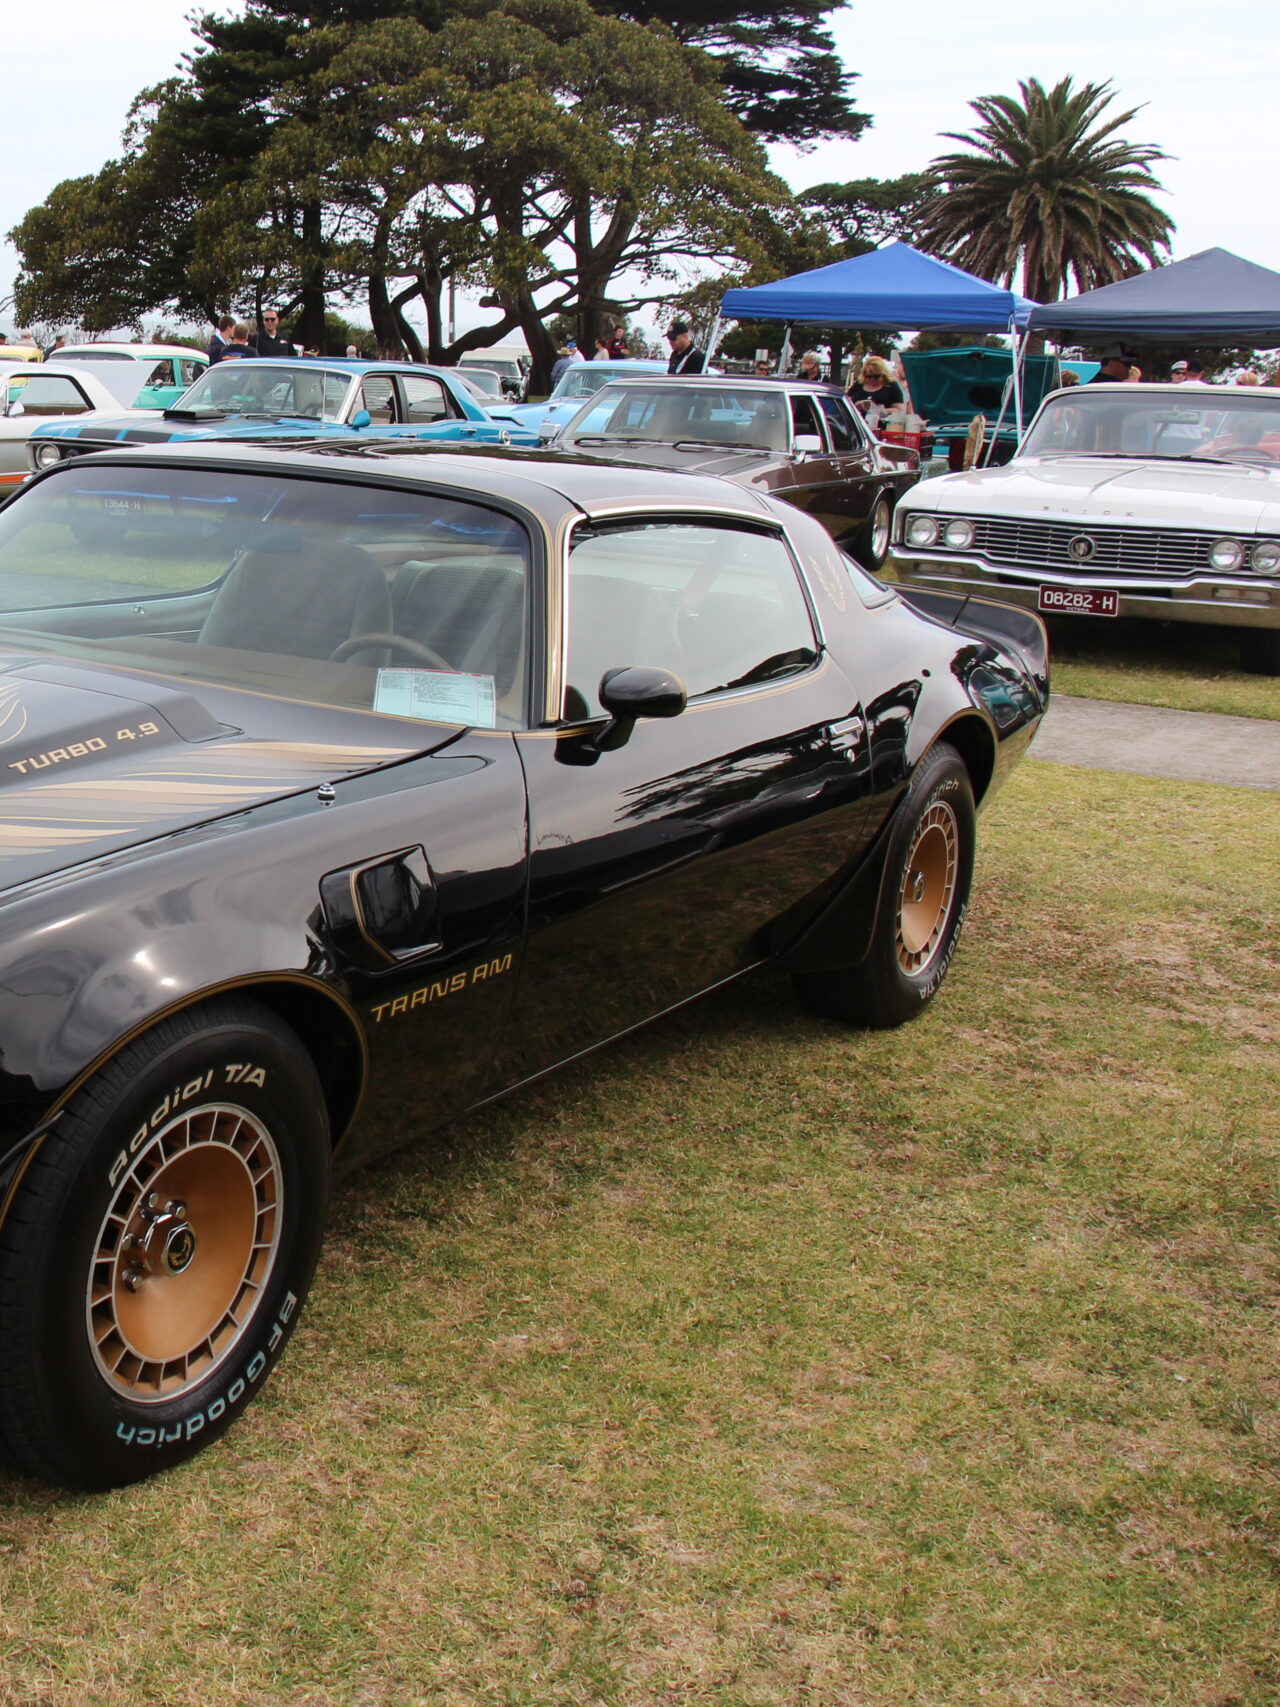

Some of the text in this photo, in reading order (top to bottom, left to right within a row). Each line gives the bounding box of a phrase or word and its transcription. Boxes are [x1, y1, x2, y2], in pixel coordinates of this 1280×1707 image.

[1042, 505, 1135, 516] BUICK
[8, 721, 160, 774] TURBO 4.9
[371, 953, 513, 1023] TRANS AM
[108, 1063, 267, 1188] Radial T/A
[116, 1290, 297, 1449] BFGoodrich
